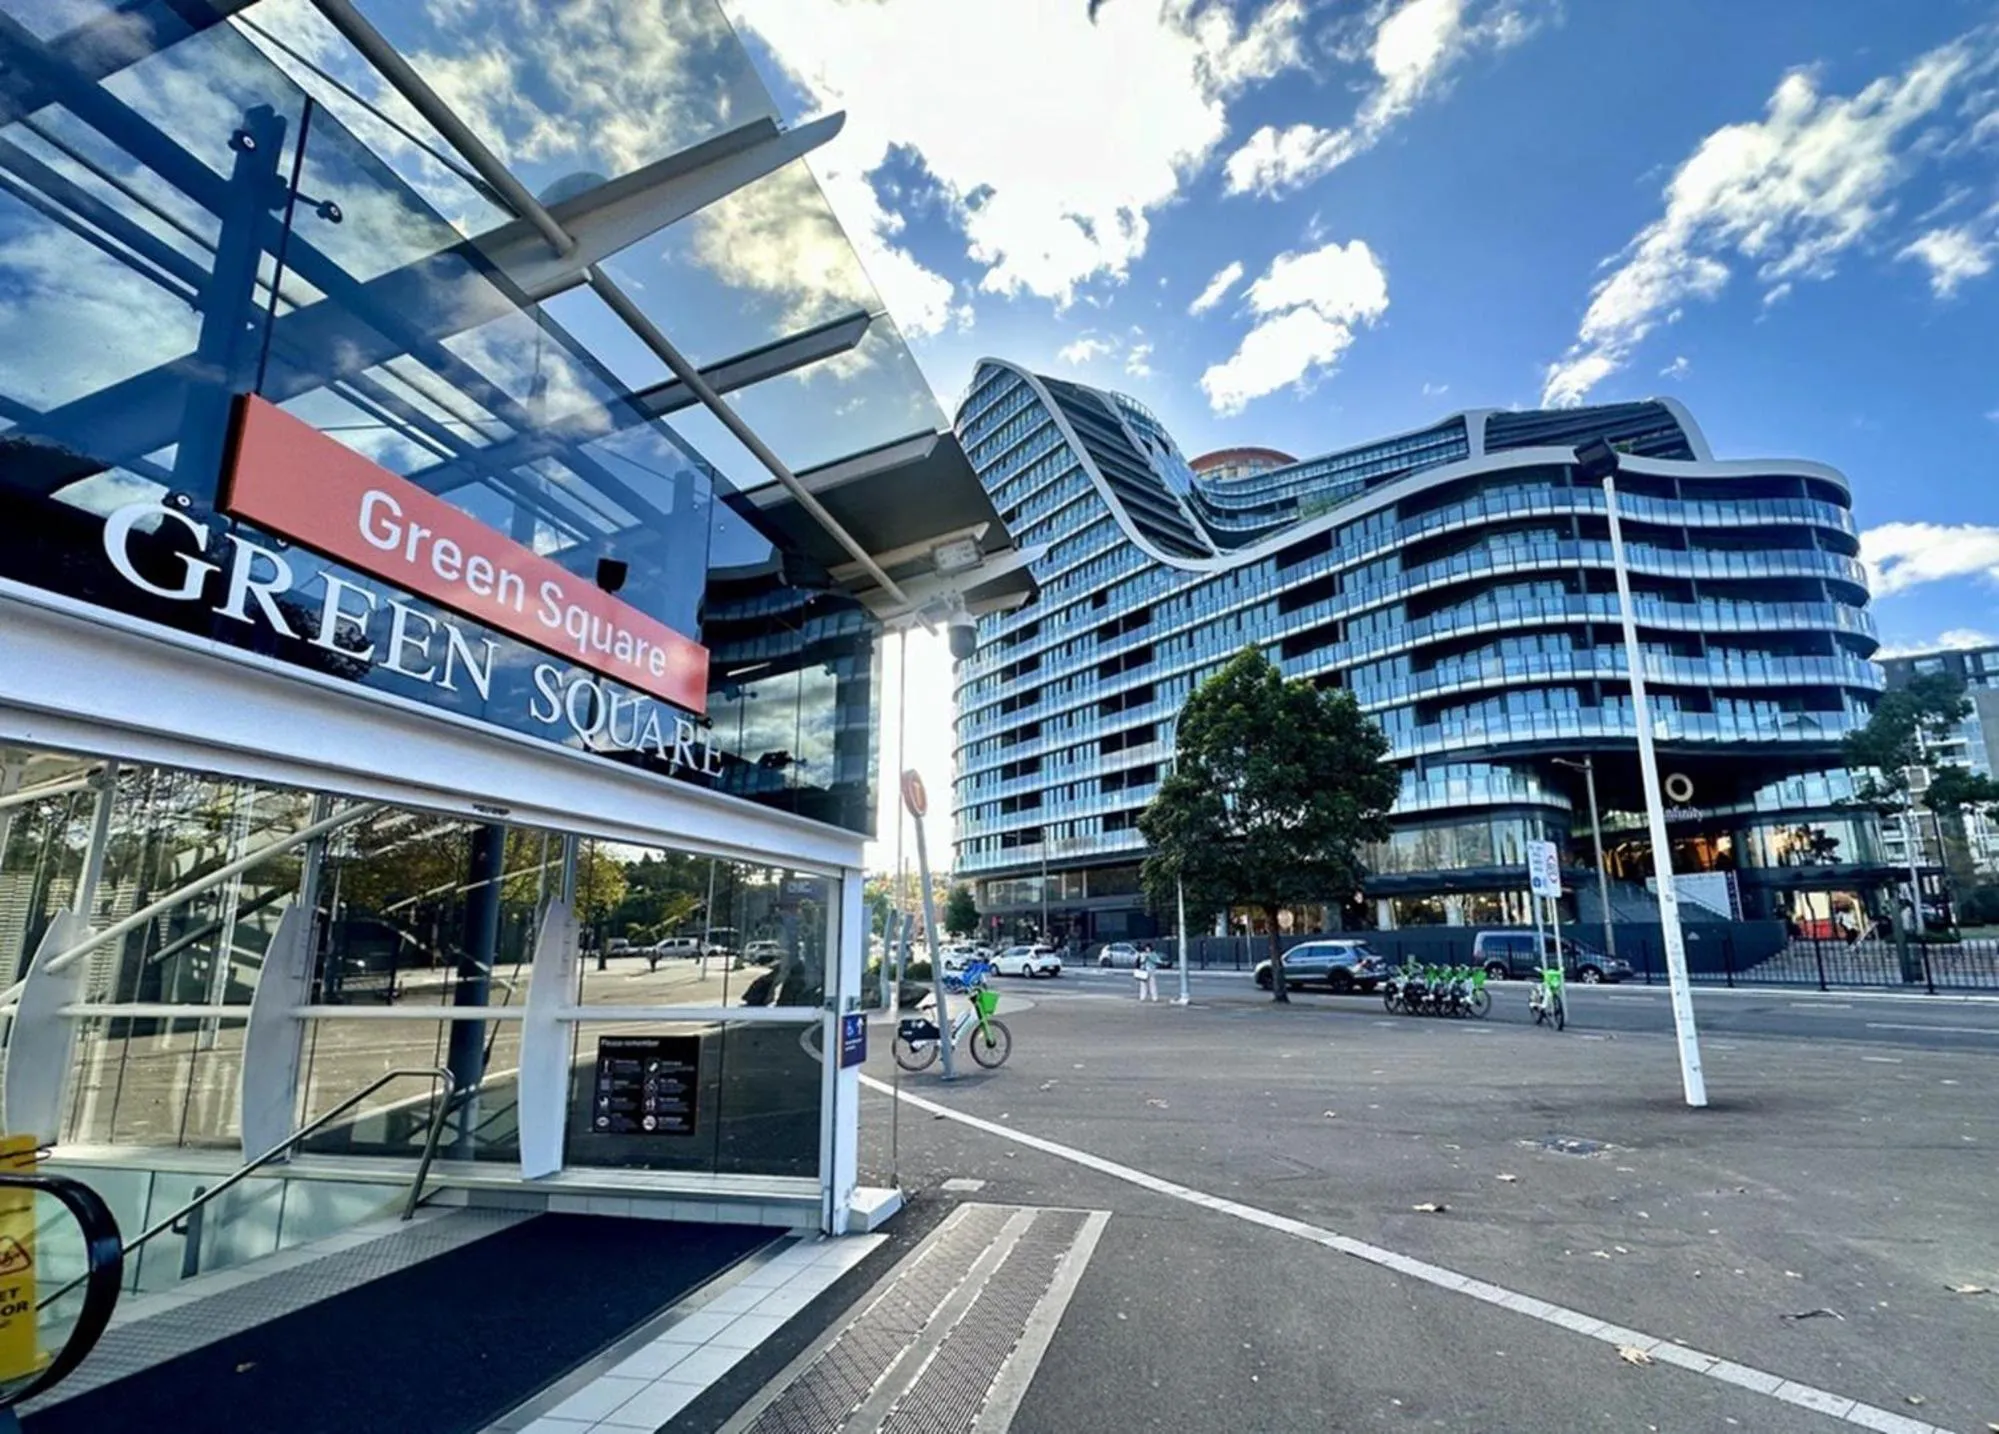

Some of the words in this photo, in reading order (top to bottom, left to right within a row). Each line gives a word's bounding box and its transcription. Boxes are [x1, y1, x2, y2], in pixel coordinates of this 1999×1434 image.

[103, 503, 502, 701] GREEN
[530, 663, 725, 778] SQUARE
[359, 489, 525, 614] Green
[538, 581, 668, 677] Square
[1663, 804, 1703, 822] nfinity
